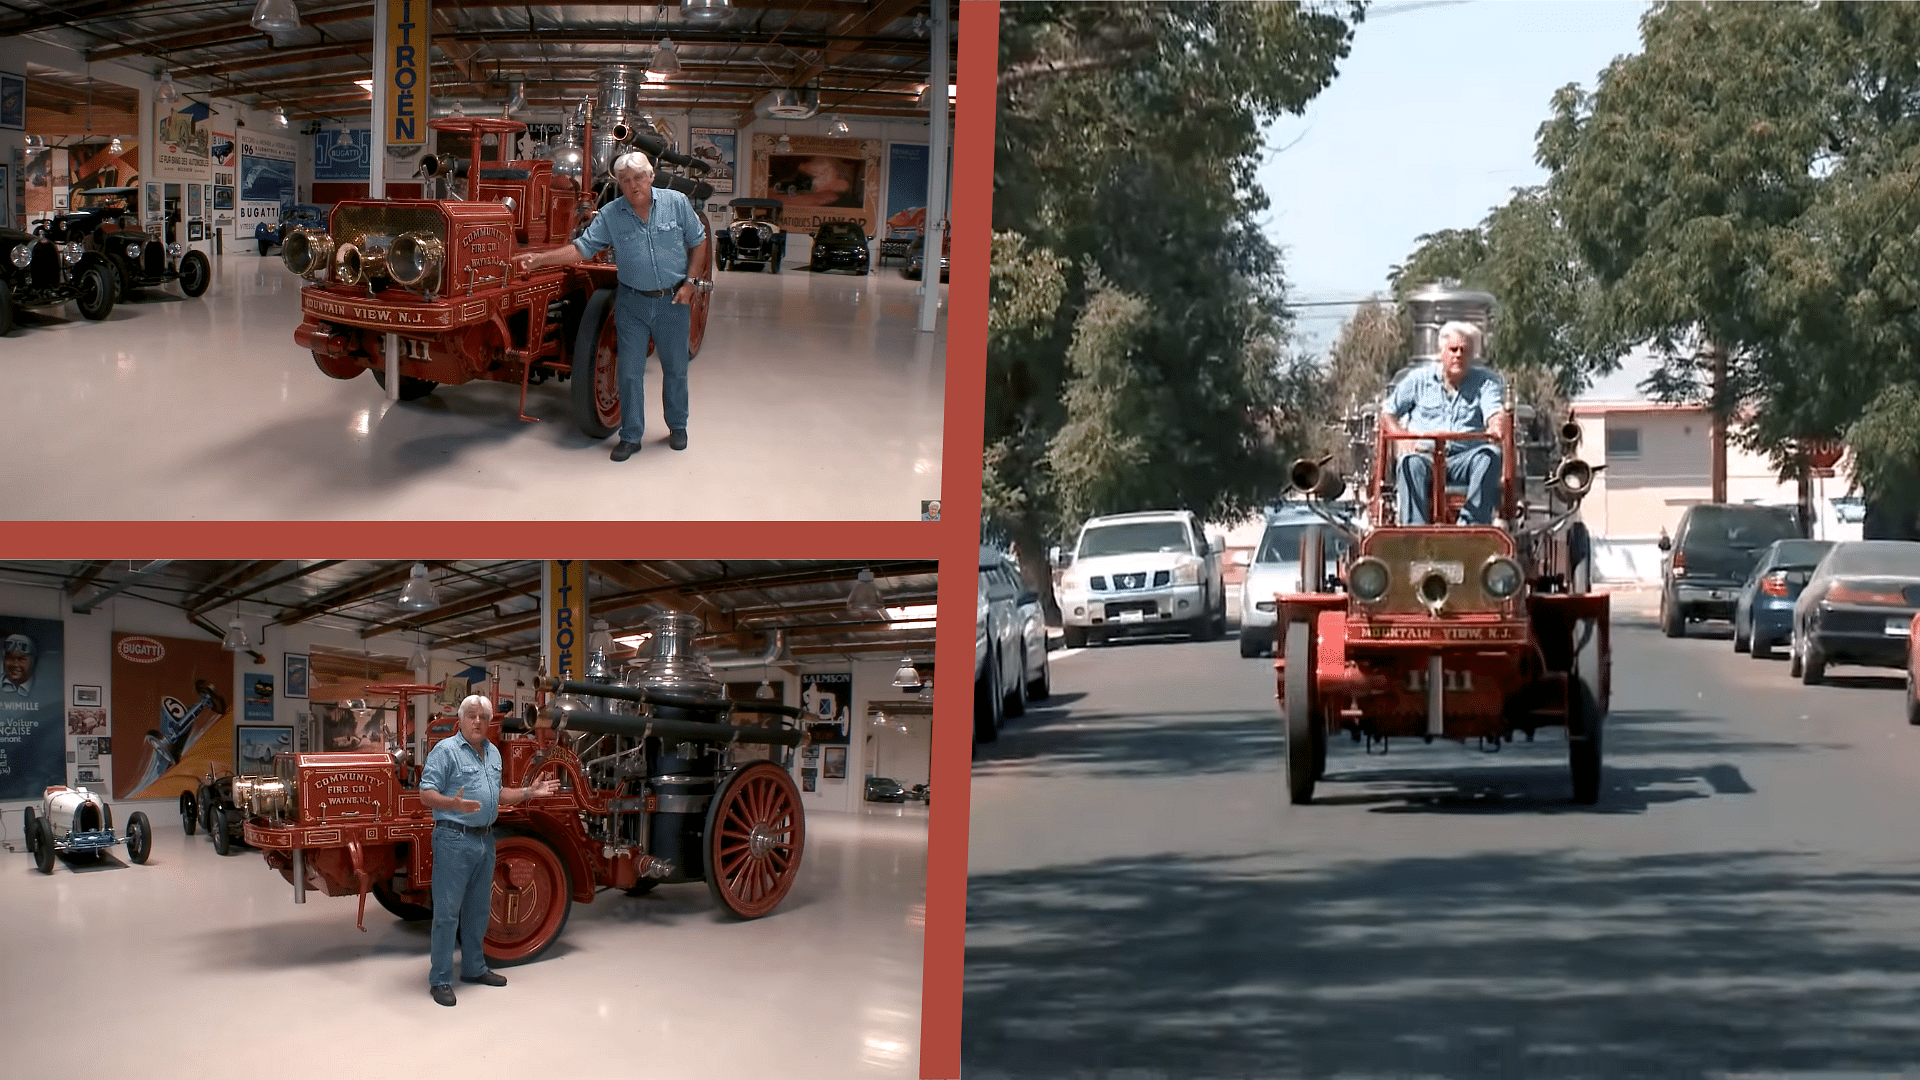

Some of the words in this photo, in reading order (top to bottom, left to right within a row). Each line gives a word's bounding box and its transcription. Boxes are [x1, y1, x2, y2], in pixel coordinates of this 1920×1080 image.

[242, 144, 254, 154] 196
[240, 208, 279, 218] BUGATTI
[462, 227, 508, 248] COMMUNITY
[472, 244, 486, 254] FIRE
[304, 298, 345, 315] MOUNTAIN
[354, 307, 392, 323] VIEW,
[399, 312, 425, 323] N.J.
[556, 560, 575, 675] ITROË
[1362, 628, 1431, 639] MOUNTAIN
[122, 643, 160, 656] BUGATTI
[803, 674, 850, 682] SALMSON
[1408, 669, 1474, 690] 111
[7, 718, 39, 727] Voiture
[314, 773, 384, 788] COMMUNITY
[328, 786, 348, 794] FIRE
